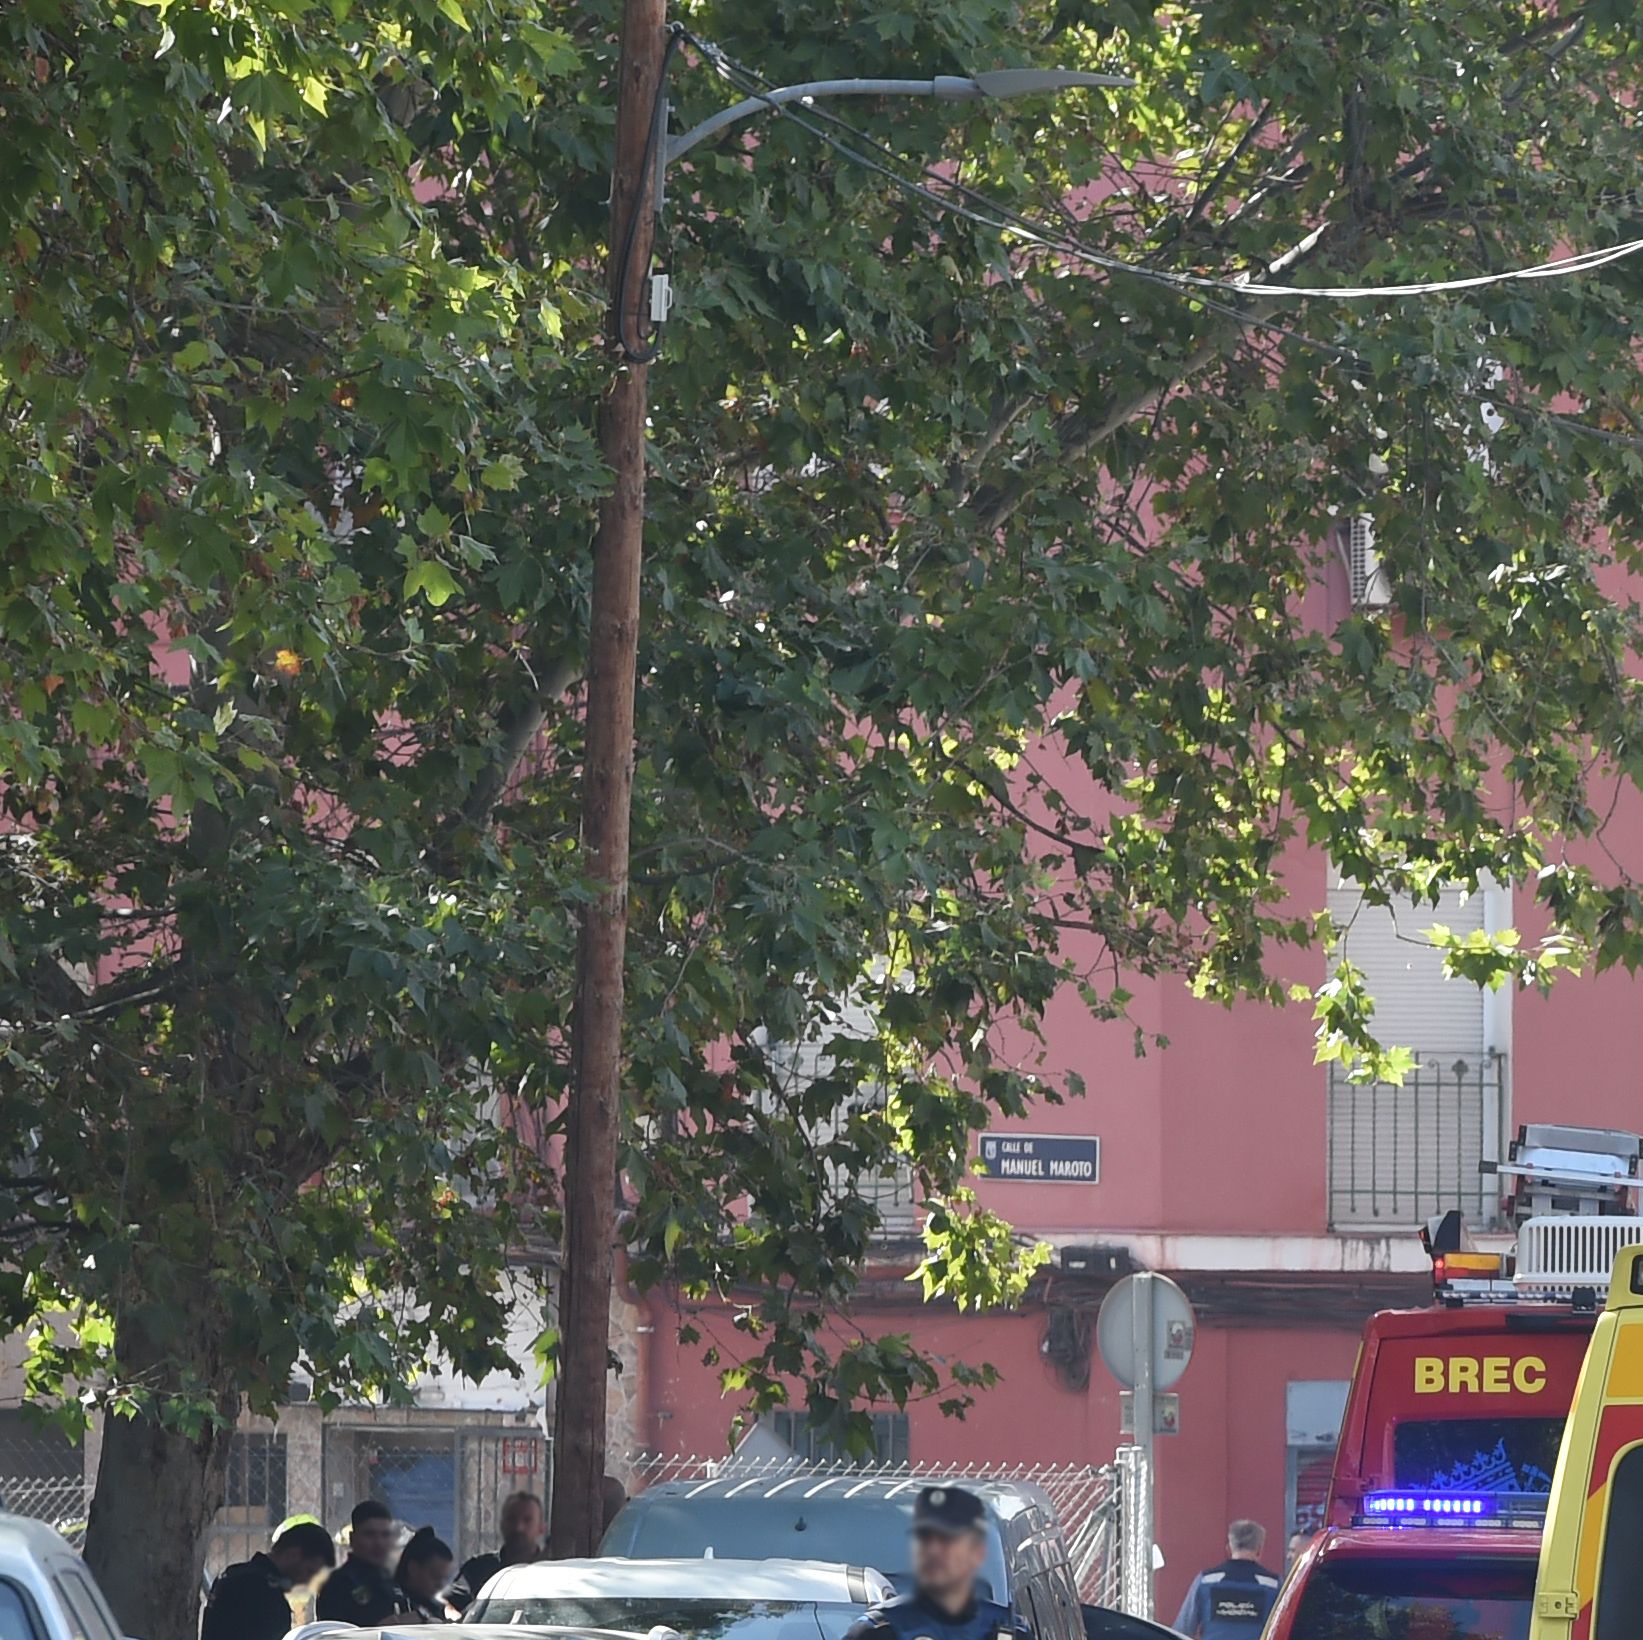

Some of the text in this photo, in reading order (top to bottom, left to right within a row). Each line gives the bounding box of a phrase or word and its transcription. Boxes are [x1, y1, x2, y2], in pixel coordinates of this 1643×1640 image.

[1001, 1141, 1034, 1154] CALLE DE
[1001, 1159, 1093, 1178] MANUEL MAROTO
[1414, 1356, 1547, 1394] BREC
